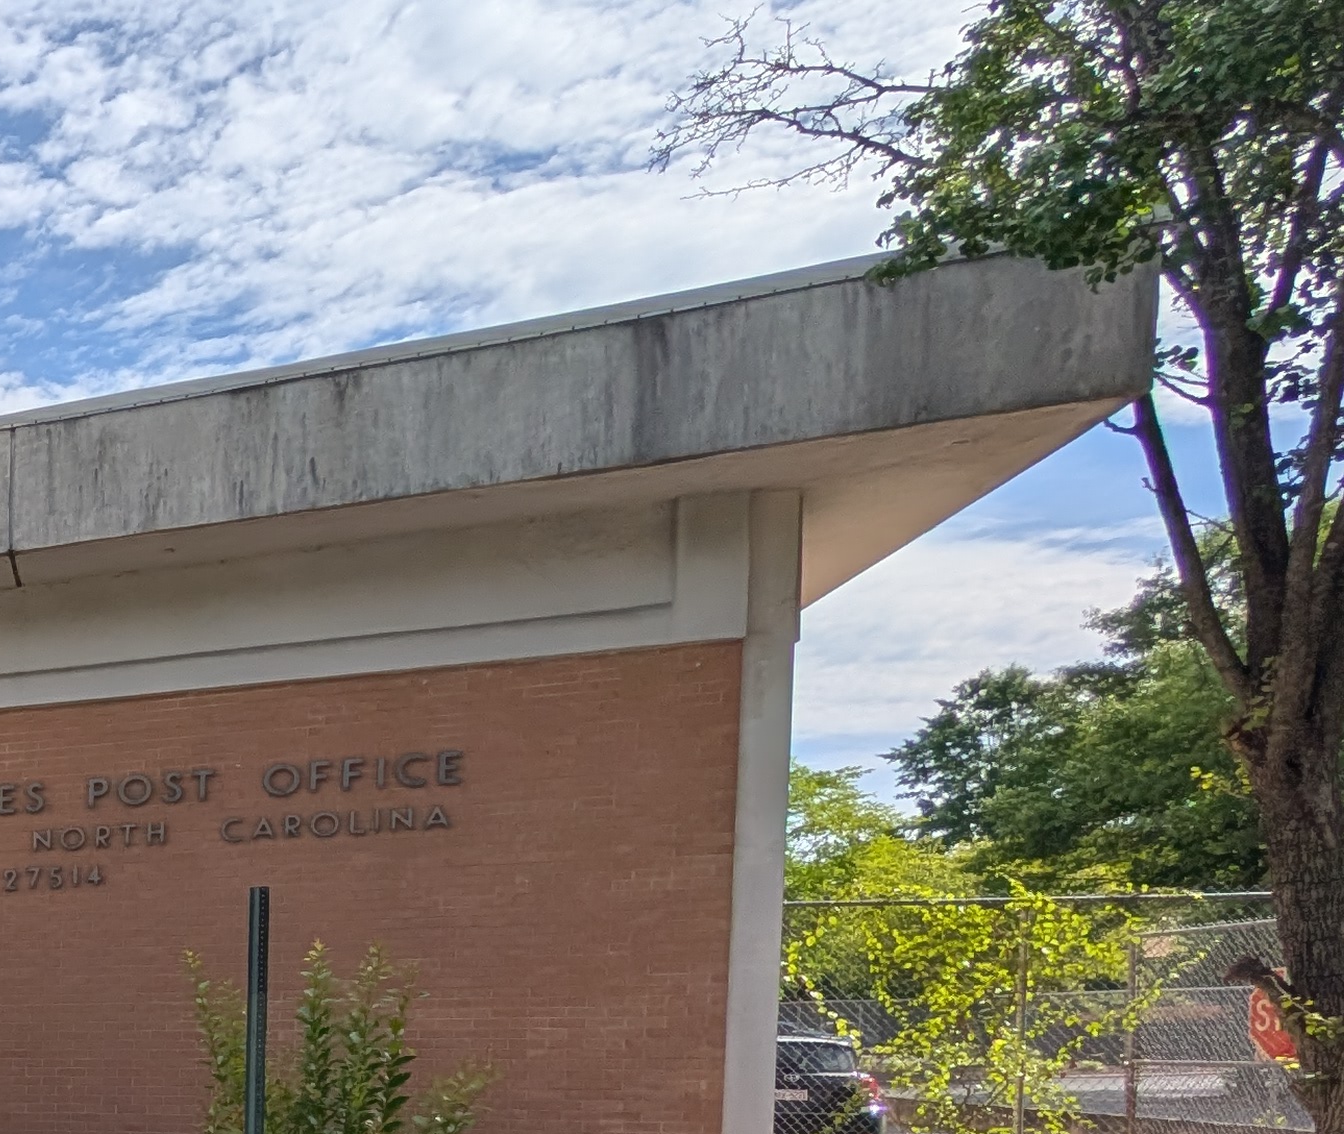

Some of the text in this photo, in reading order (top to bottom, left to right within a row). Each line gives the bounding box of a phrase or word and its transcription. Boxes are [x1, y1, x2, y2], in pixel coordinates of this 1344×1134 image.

[87, 769, 216, 808] POST
[263, 751, 463, 796] OFFICE
[32, 821, 166, 850] NORTH
[221, 806, 449, 842] CAROLINA
[3, 865, 102, 891] 27514
